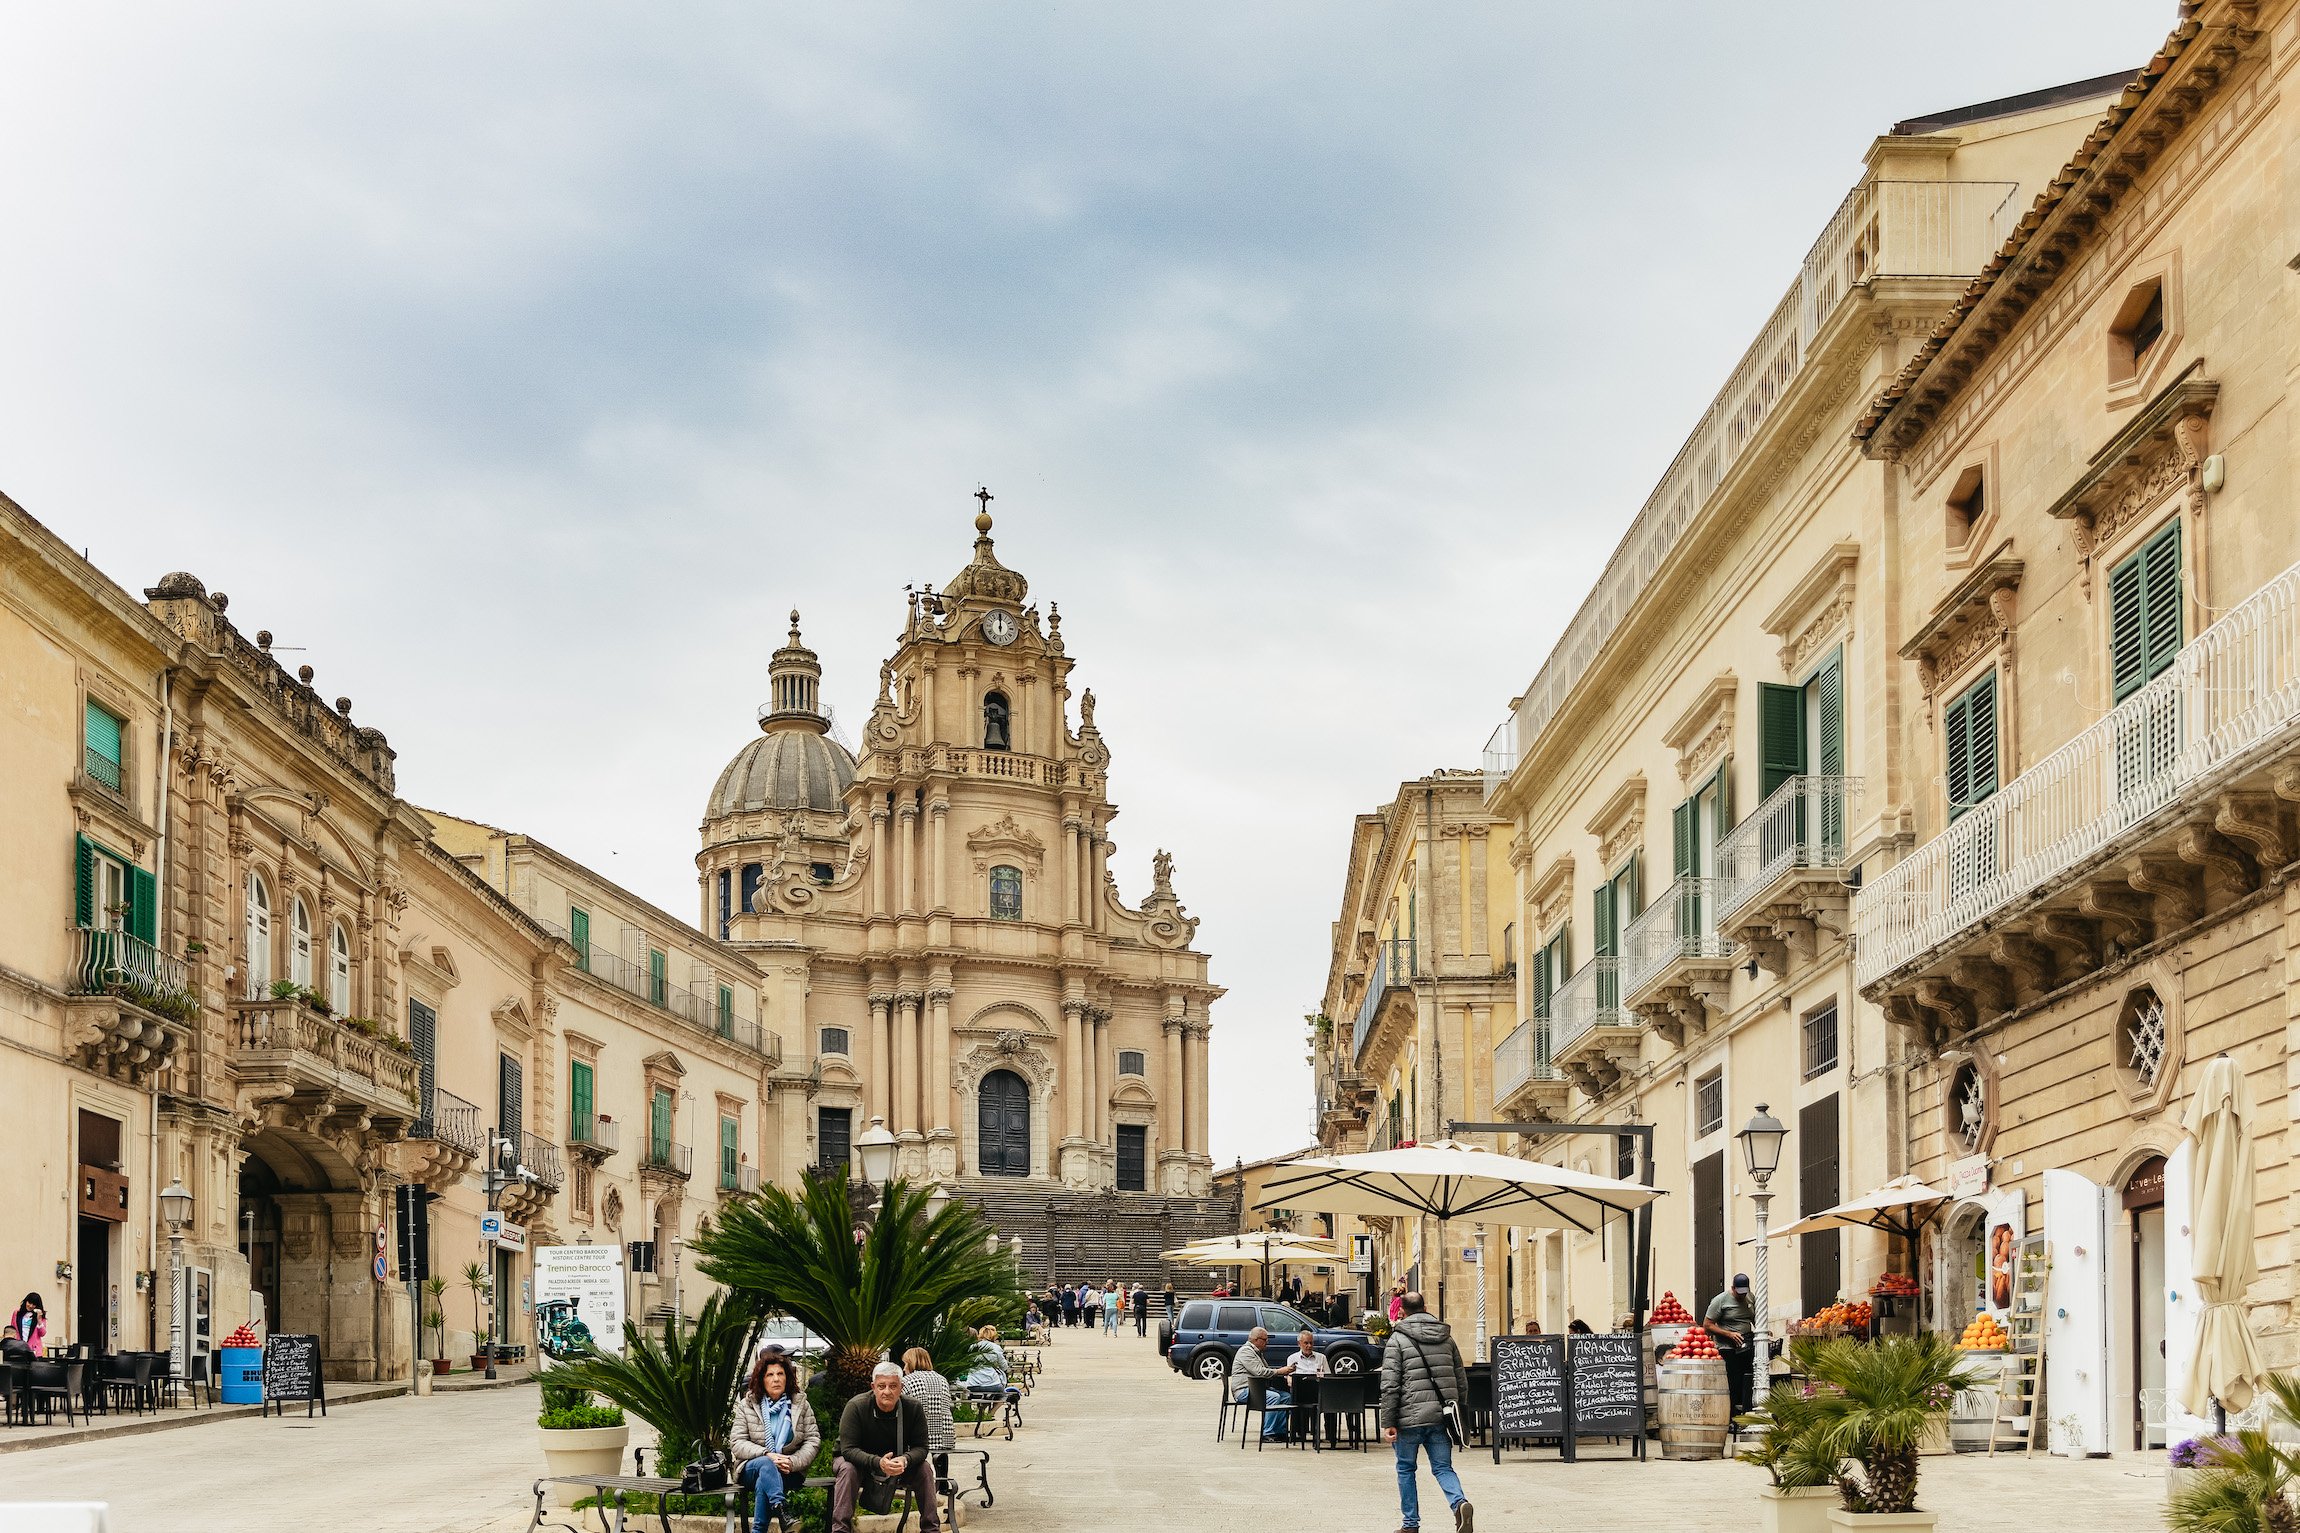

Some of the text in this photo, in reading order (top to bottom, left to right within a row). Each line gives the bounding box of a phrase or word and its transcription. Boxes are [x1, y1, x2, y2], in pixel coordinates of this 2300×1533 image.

[547, 1264, 611, 1272] Trenino Barocco
[1575, 1340, 1632, 1355] ARANCINI
